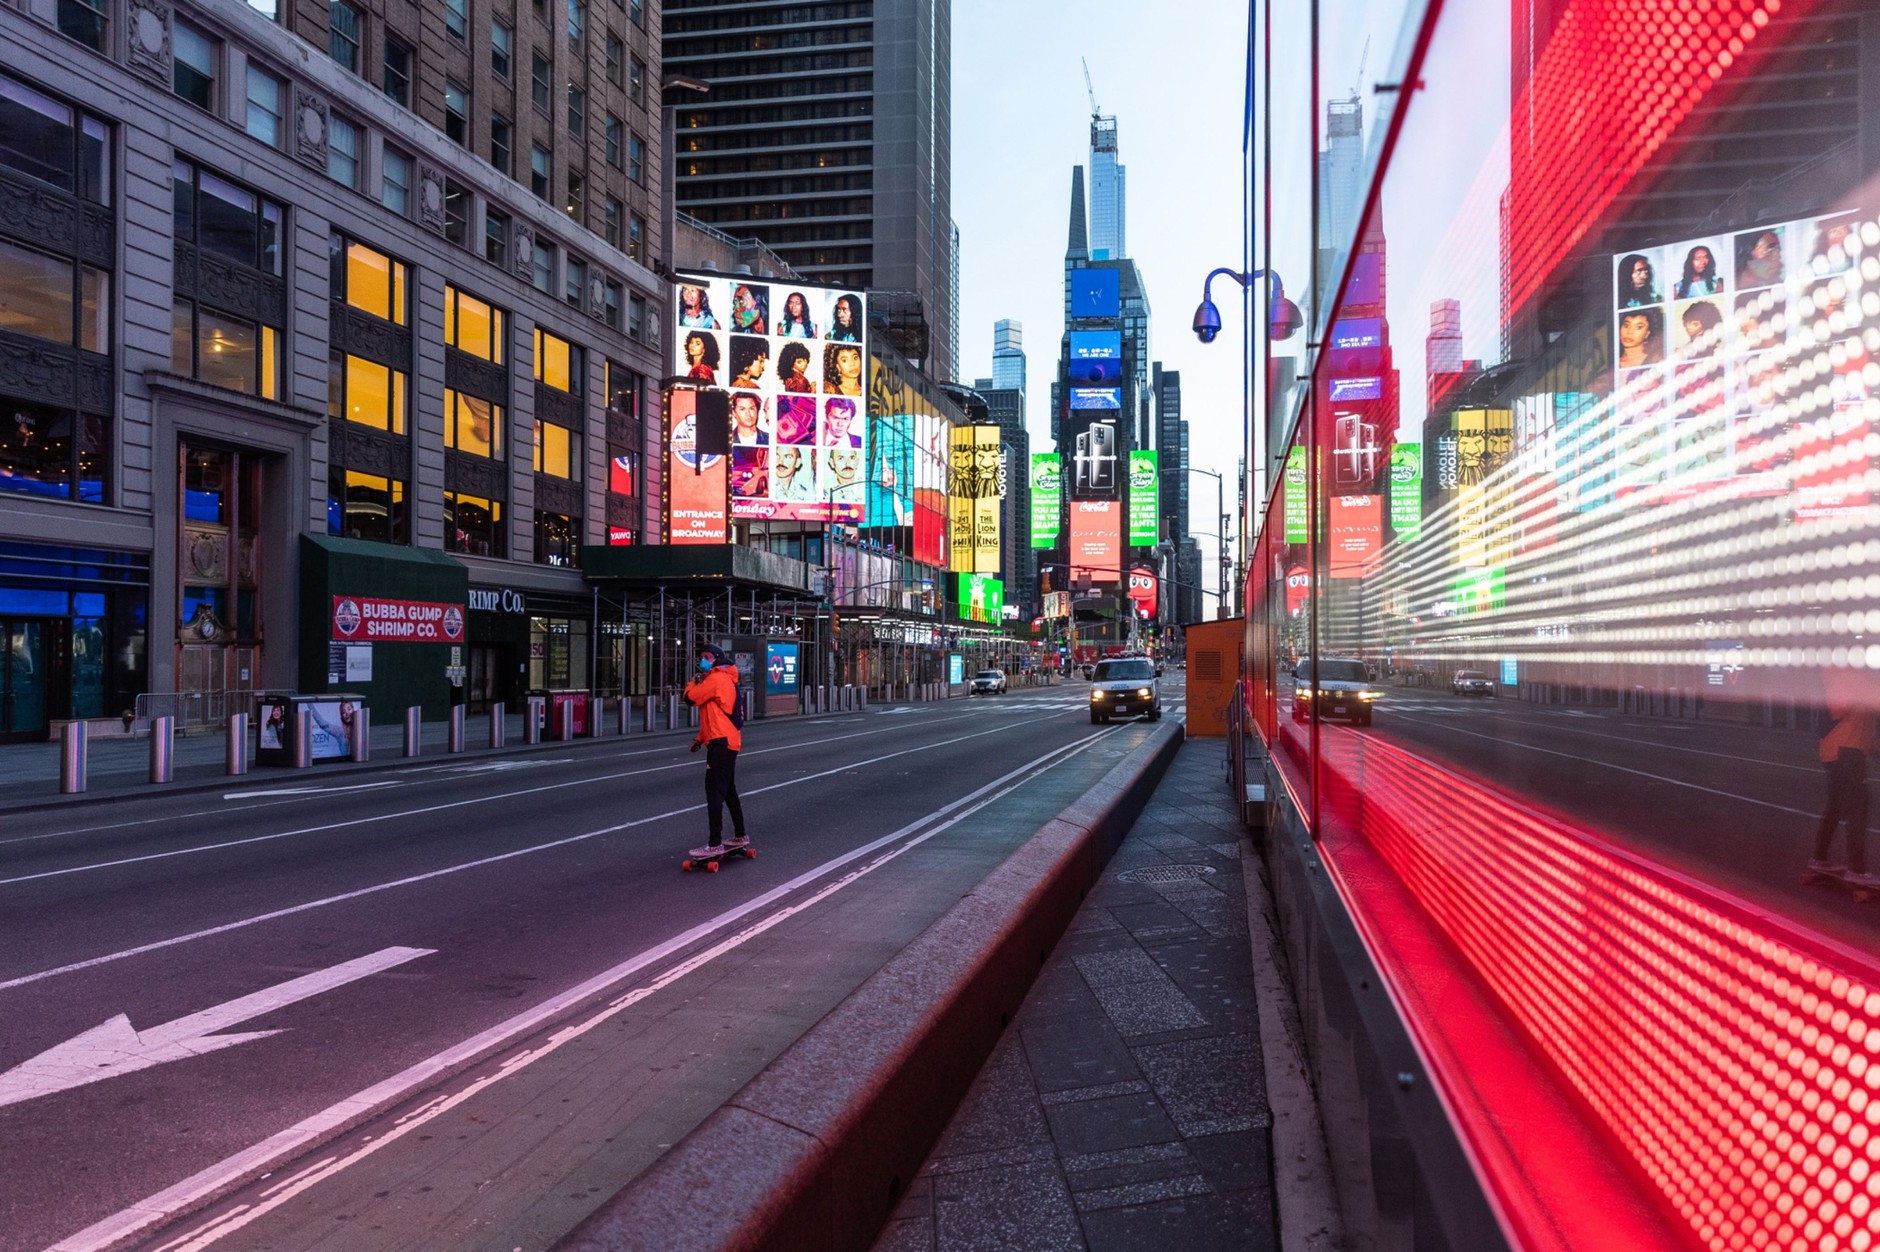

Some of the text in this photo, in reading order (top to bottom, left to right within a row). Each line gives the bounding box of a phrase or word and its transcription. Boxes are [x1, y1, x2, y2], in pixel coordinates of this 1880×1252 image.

[998, 450, 1007, 500] NOVOTEL
[673, 511, 723, 519] ENTRANCE
[672, 530, 725, 538] BROADWAY
[978, 524, 996, 534] LION
[977, 535, 998, 547] KING
[468, 589, 525, 613] RIMP Co.
[363, 603, 442, 620] BUBBA GUMP
[367, 621, 437, 637] SHRIMP CO.
